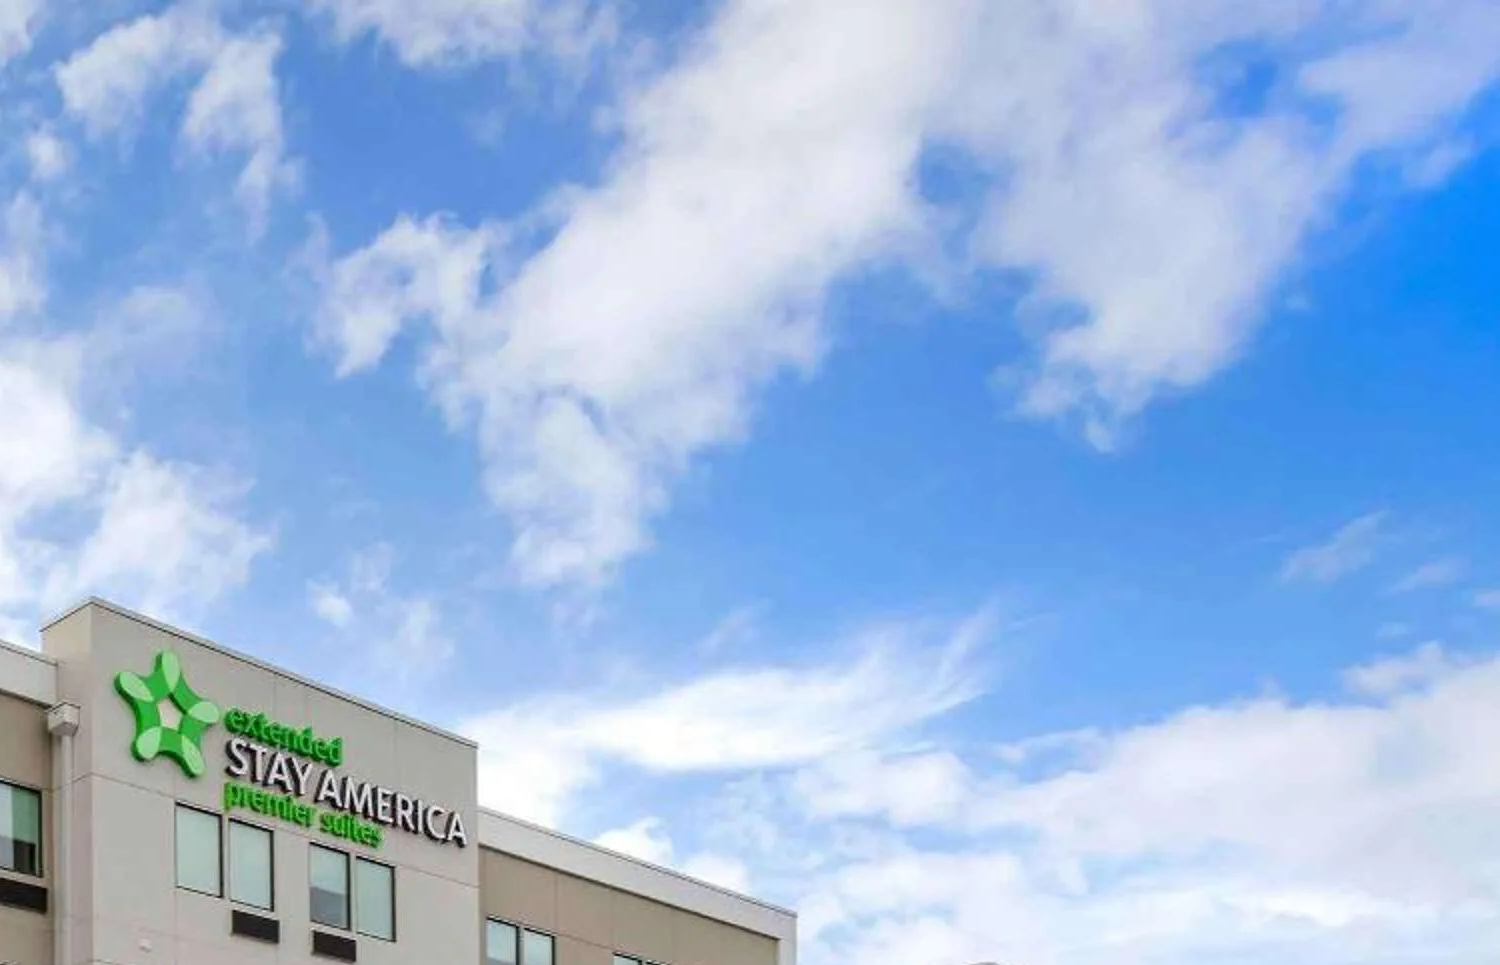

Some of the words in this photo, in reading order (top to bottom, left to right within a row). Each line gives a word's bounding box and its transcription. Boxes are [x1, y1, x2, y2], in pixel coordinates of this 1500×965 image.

[225, 709, 343, 767] extended
[224, 783, 316, 827] premier
[320, 811, 383, 848] suites
[227, 739, 312, 796] STAY
[315, 769, 468, 848] AMERICA
